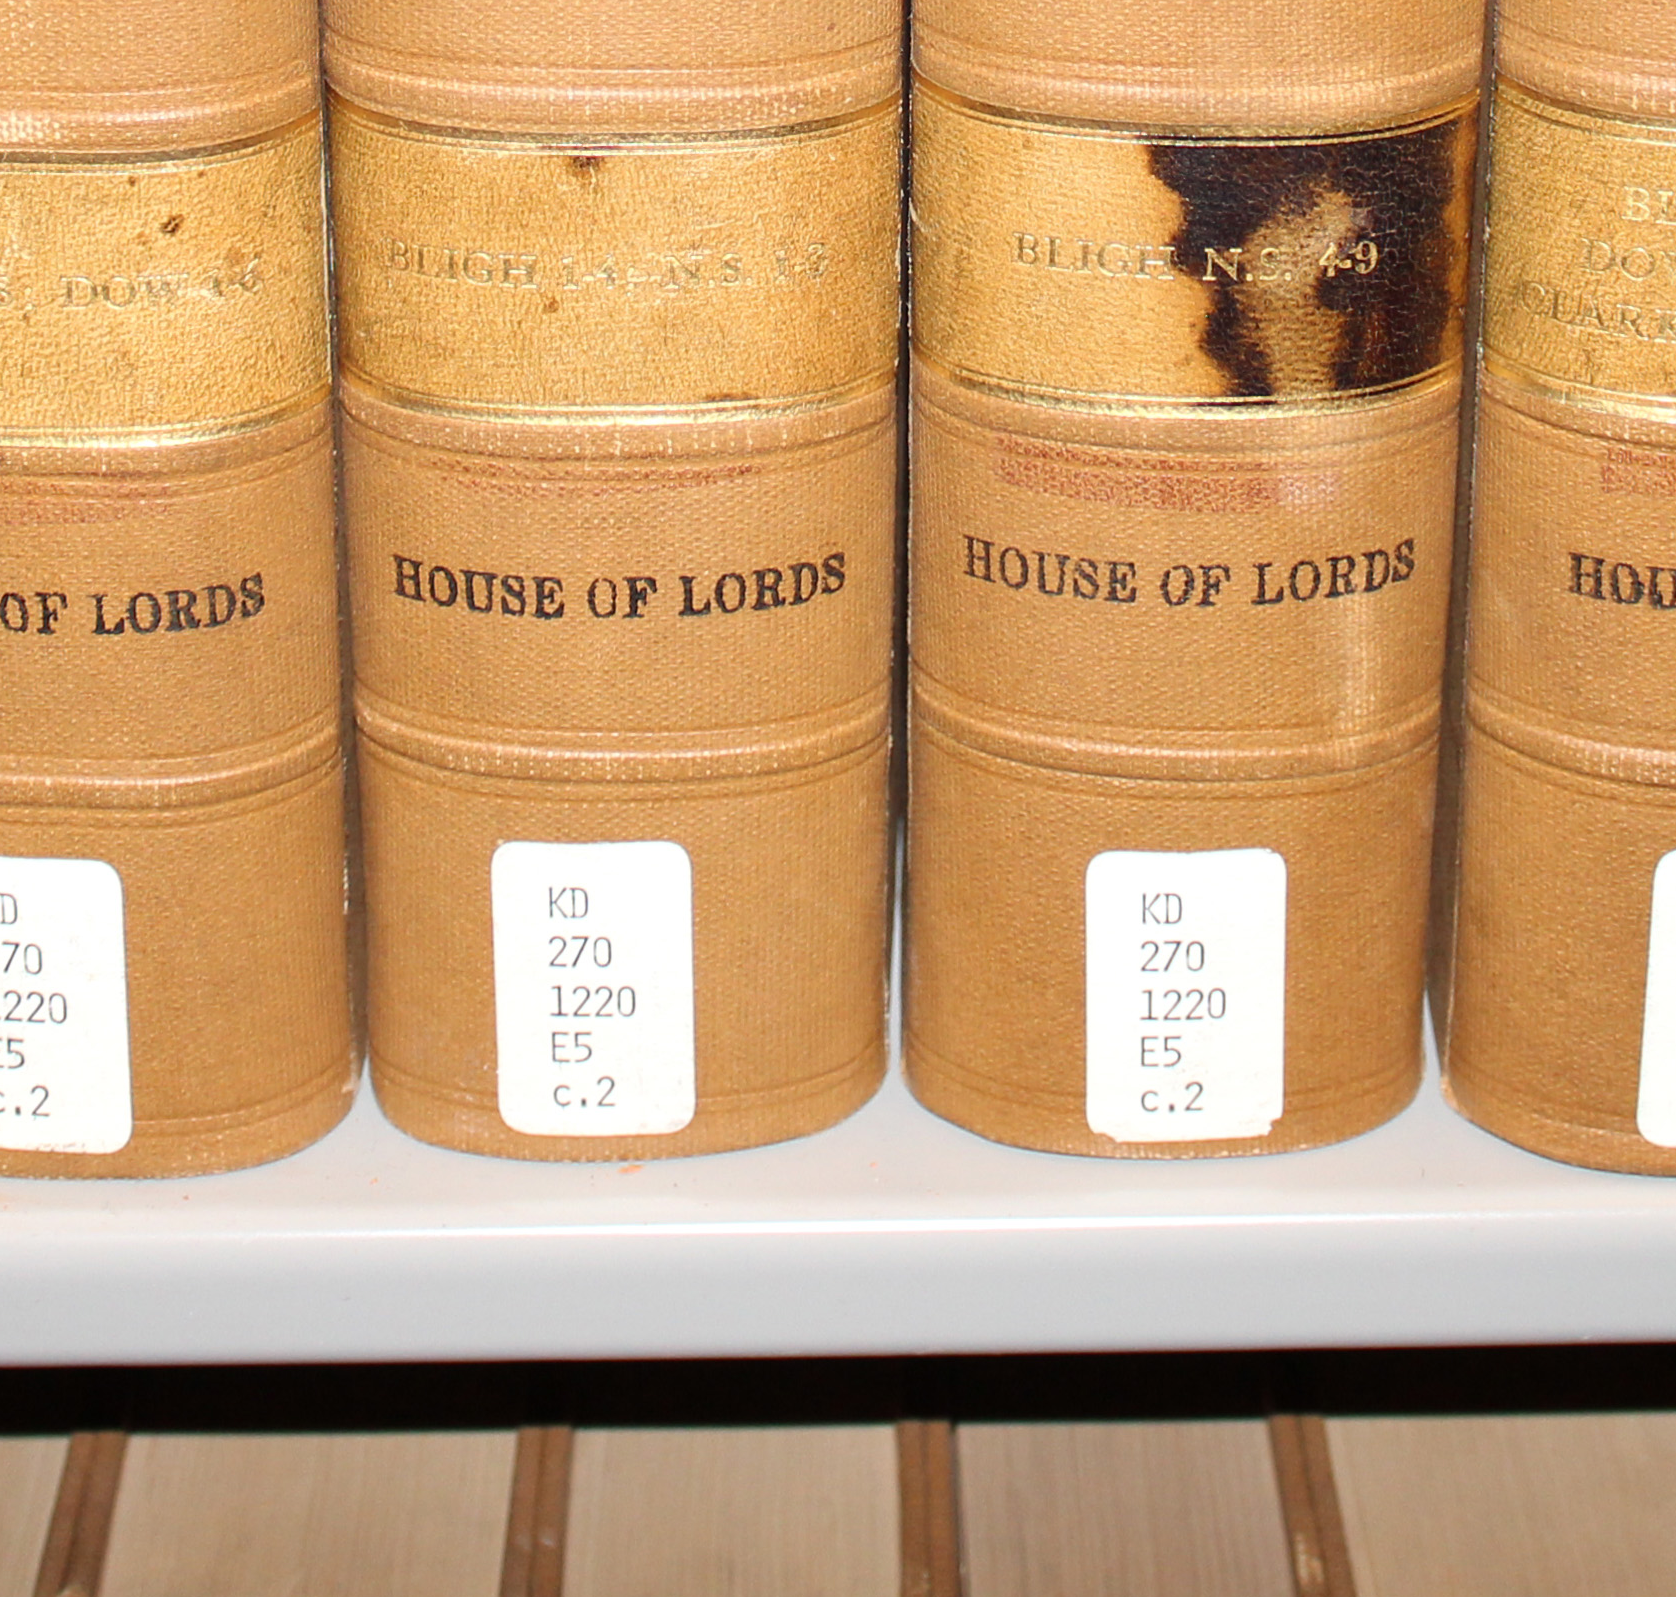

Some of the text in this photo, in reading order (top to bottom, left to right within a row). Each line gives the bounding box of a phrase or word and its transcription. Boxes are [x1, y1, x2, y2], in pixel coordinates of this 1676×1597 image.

[1013, 232, 1379, 282] BLIGH N.S. 4-9
[392, 552, 847, 622] HOUSE OF LORDS
[962, 535, 1418, 609] HOUSE OF LORDS
[93, 572, 266, 637] LORDS
[548, 886, 590, 919] KD
[1141, 892, 1184, 925] KD
[548, 935, 613, 969] 270
[1140, 940, 1206, 973] 270
[549, 985, 637, 1018] 1220
[1139, 987, 1227, 1021] 1220
[550, 1031, 593, 1064] E5
[1140, 1035, 1183, 1068] E5
[553, 1075, 617, 1108] c.2
[1140, 1081, 1205, 1113] c.2
